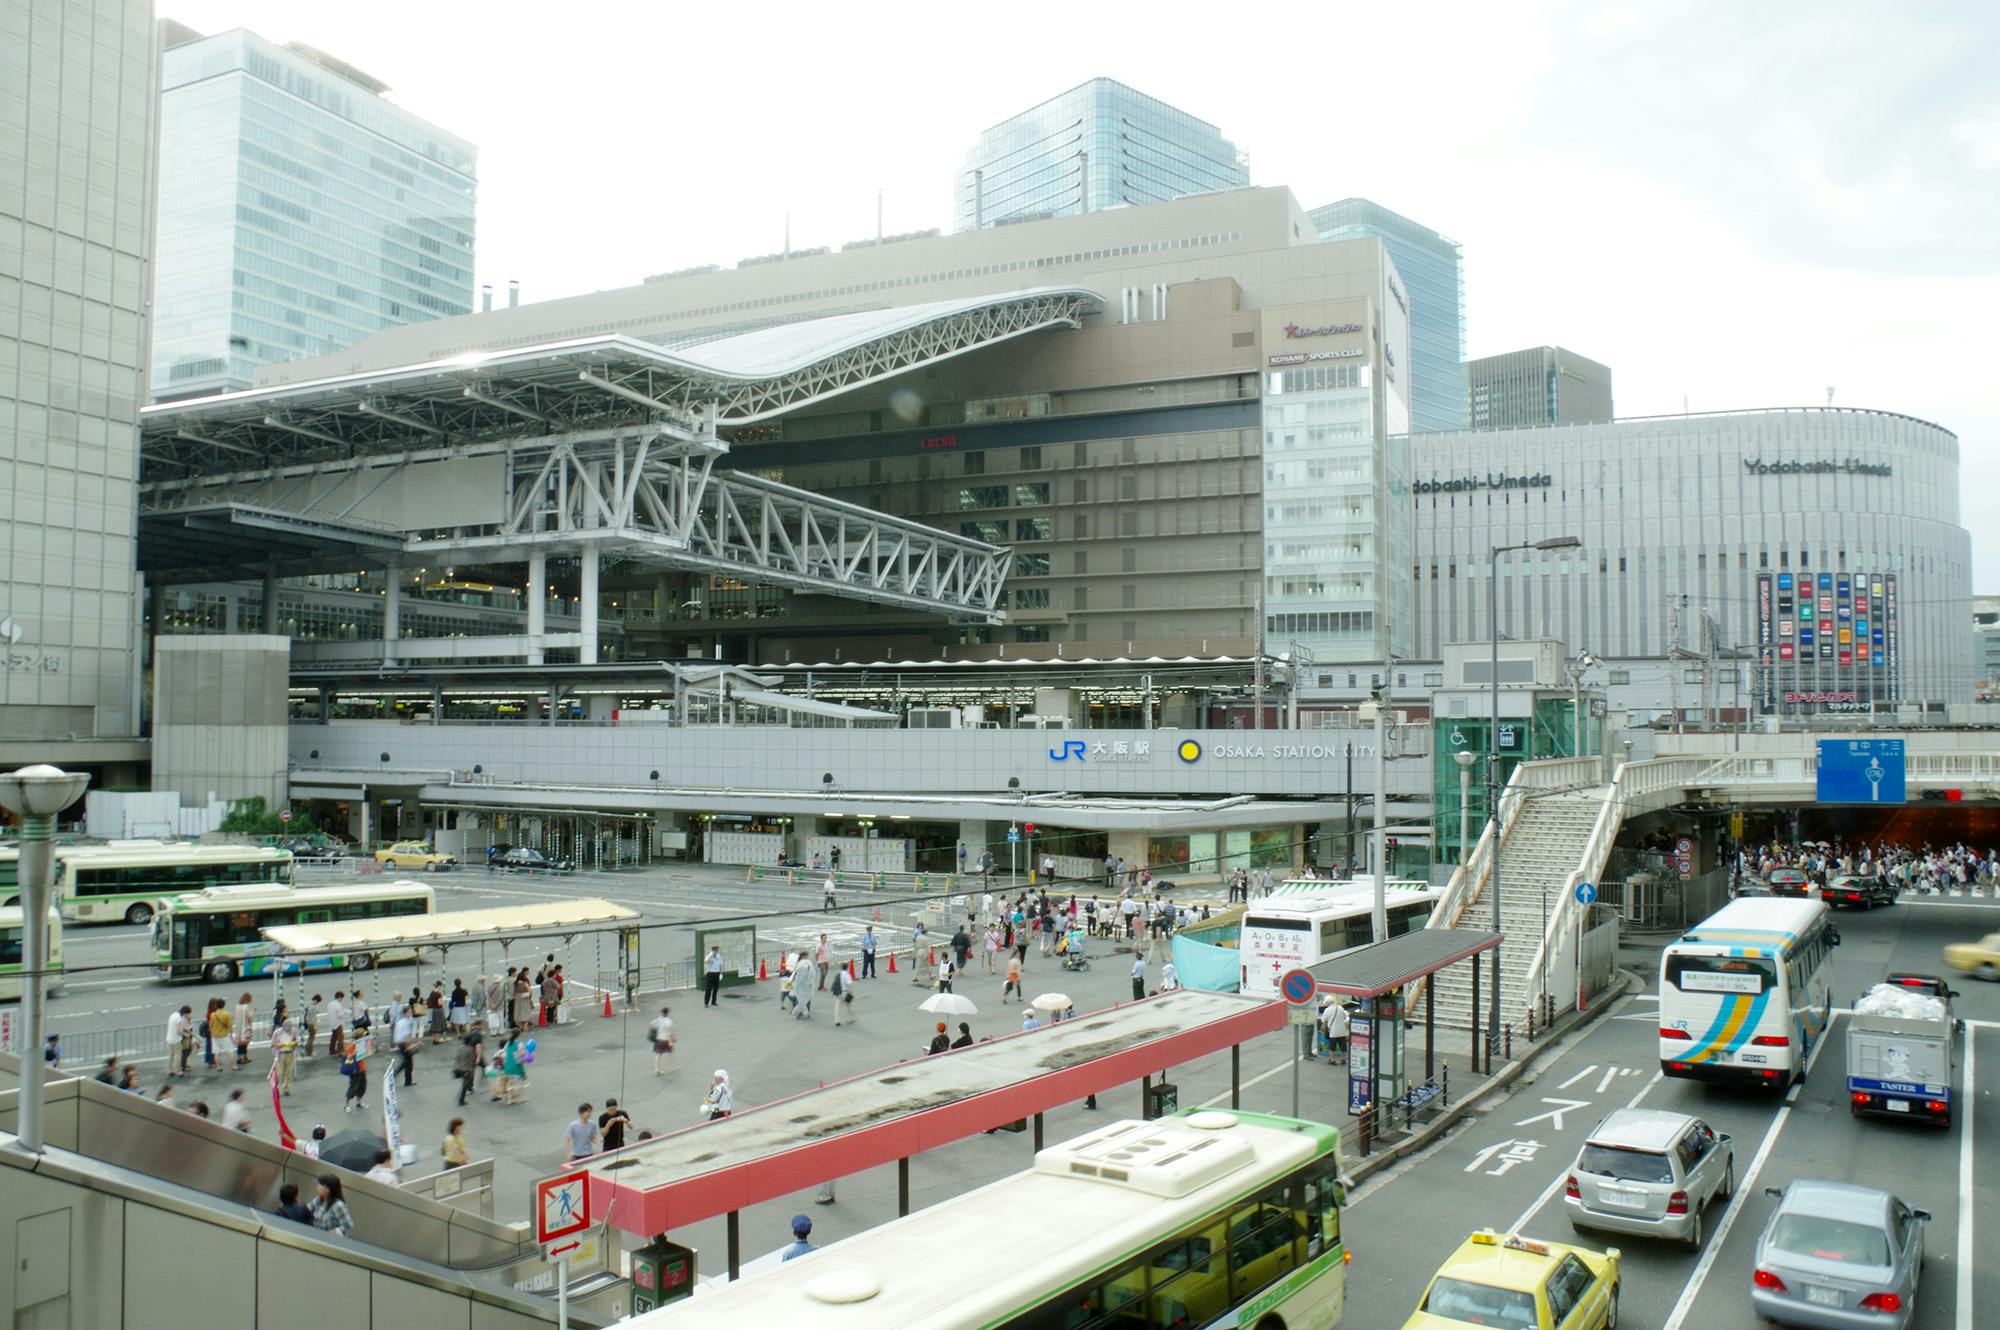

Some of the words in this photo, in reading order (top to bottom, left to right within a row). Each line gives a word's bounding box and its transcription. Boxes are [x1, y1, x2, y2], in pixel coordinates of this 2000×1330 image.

[1270, 354, 1304, 365] KONAMI
[1308, 350, 1340, 361] SPORTS
[1341, 348, 1364, 358] CLUB
[1744, 458, 1892, 477] Yodobashi-Umeda
[1049, 740, 1086, 762] JR
[1092, 740, 1150, 755] 大阪駅
[1213, 744, 1266, 758] OSAKA
[1272, 744, 1336, 758] STATION
[1878, 741, 1901, 751] 十三
[1868, 769, 1881, 778] 176
[1670, 1020, 1688, 1030] JR
[1880, 1081, 1916, 1092] TASTER
[641, 1275, 648, 1286] 2
[672, 1271, 680, 1285] 2
[637, 1300, 644, 1311] 3
